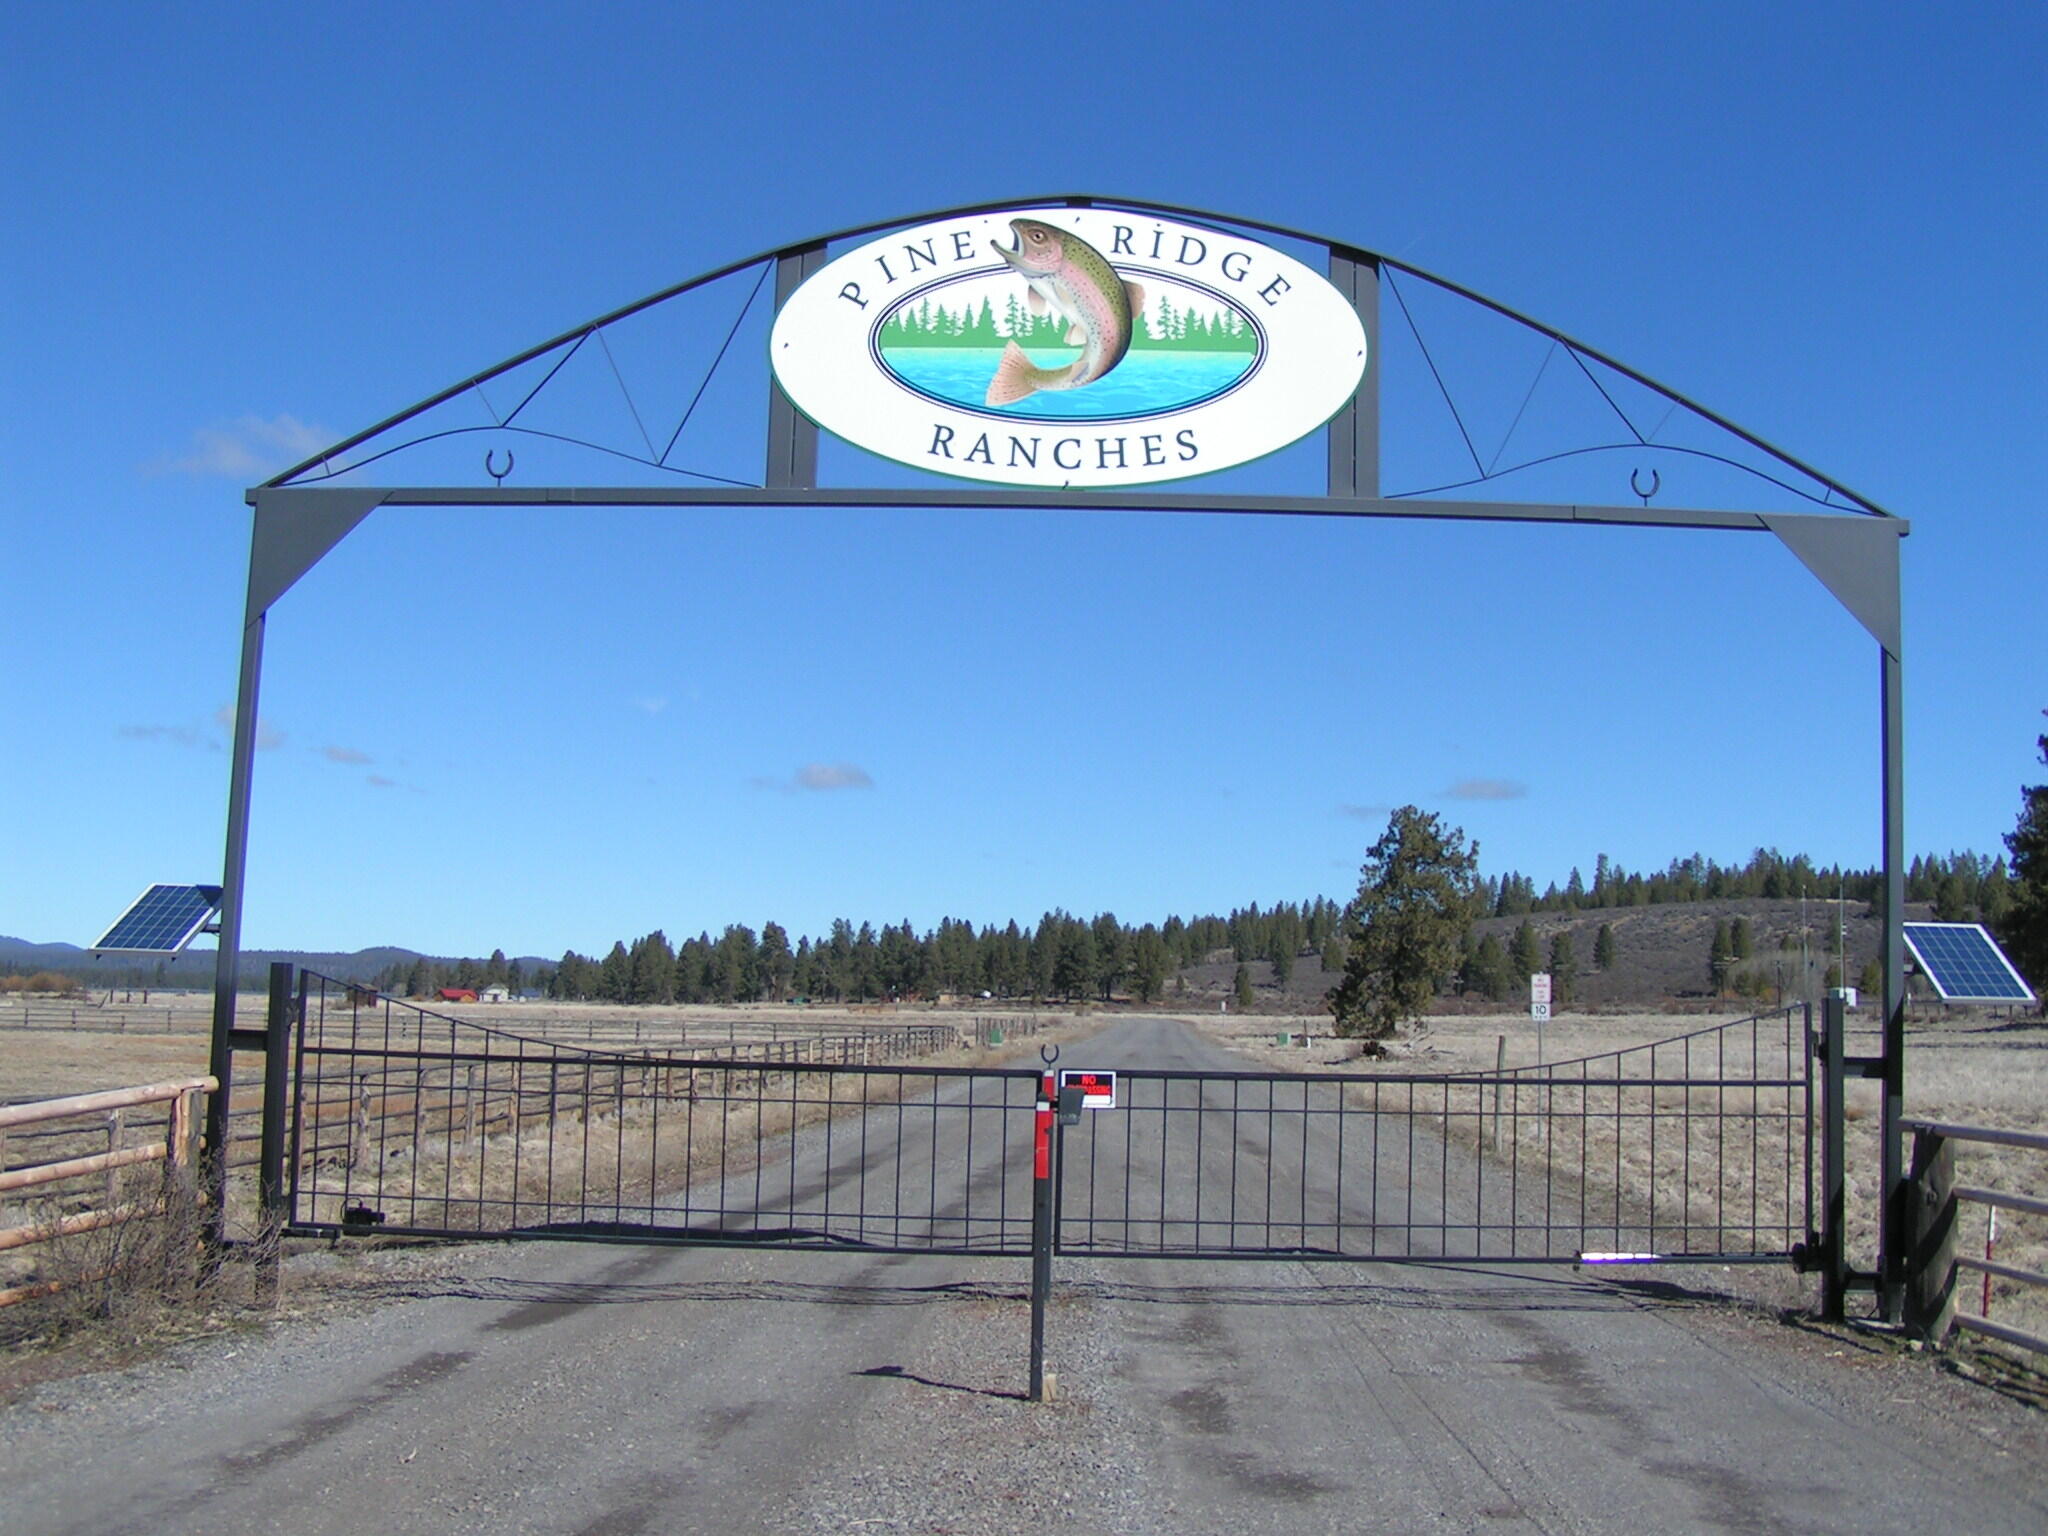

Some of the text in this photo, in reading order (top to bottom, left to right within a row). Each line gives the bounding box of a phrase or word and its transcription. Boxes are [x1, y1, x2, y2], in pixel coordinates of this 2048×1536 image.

[839, 225, 1292, 310] PINE RIDGE
[927, 424, 1199, 470] RANCHES
[1535, 1004, 1547, 1015] 10
[1081, 1075, 1097, 1085] NO
